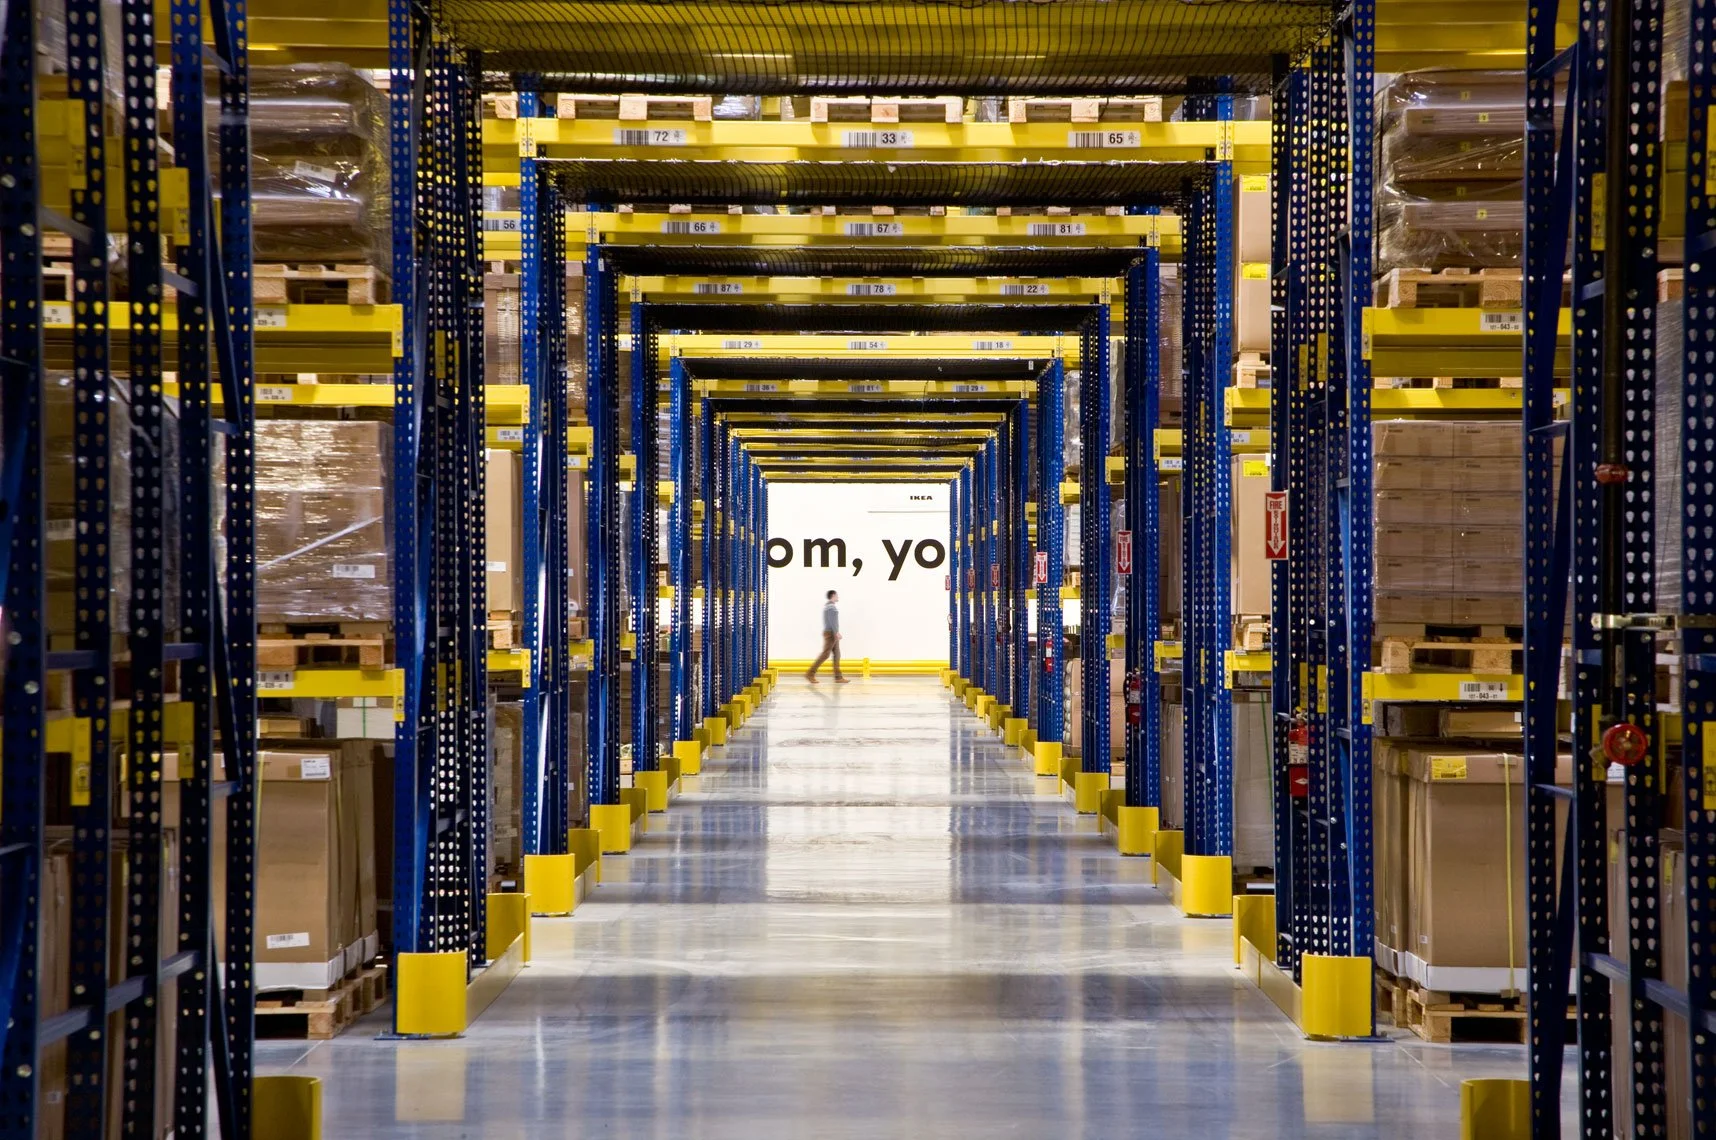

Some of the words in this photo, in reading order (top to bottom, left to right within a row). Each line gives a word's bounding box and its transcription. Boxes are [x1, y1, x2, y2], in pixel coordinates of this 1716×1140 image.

[655, 131, 669, 142] 72
[882, 133, 896, 144] 33
[1109, 133, 1123, 144] 65
[503, 220, 515, 229] 56
[694, 222, 706, 232] 66
[877, 224, 889, 233] 67
[1060, 224, 1071, 233] 81
[721, 284, 731, 292] 87
[874, 285, 884, 293] 78
[1027, 285, 1038, 293] 22
[1269, 500, 1283, 510] FIRE
[881, 538, 946, 581] yo
